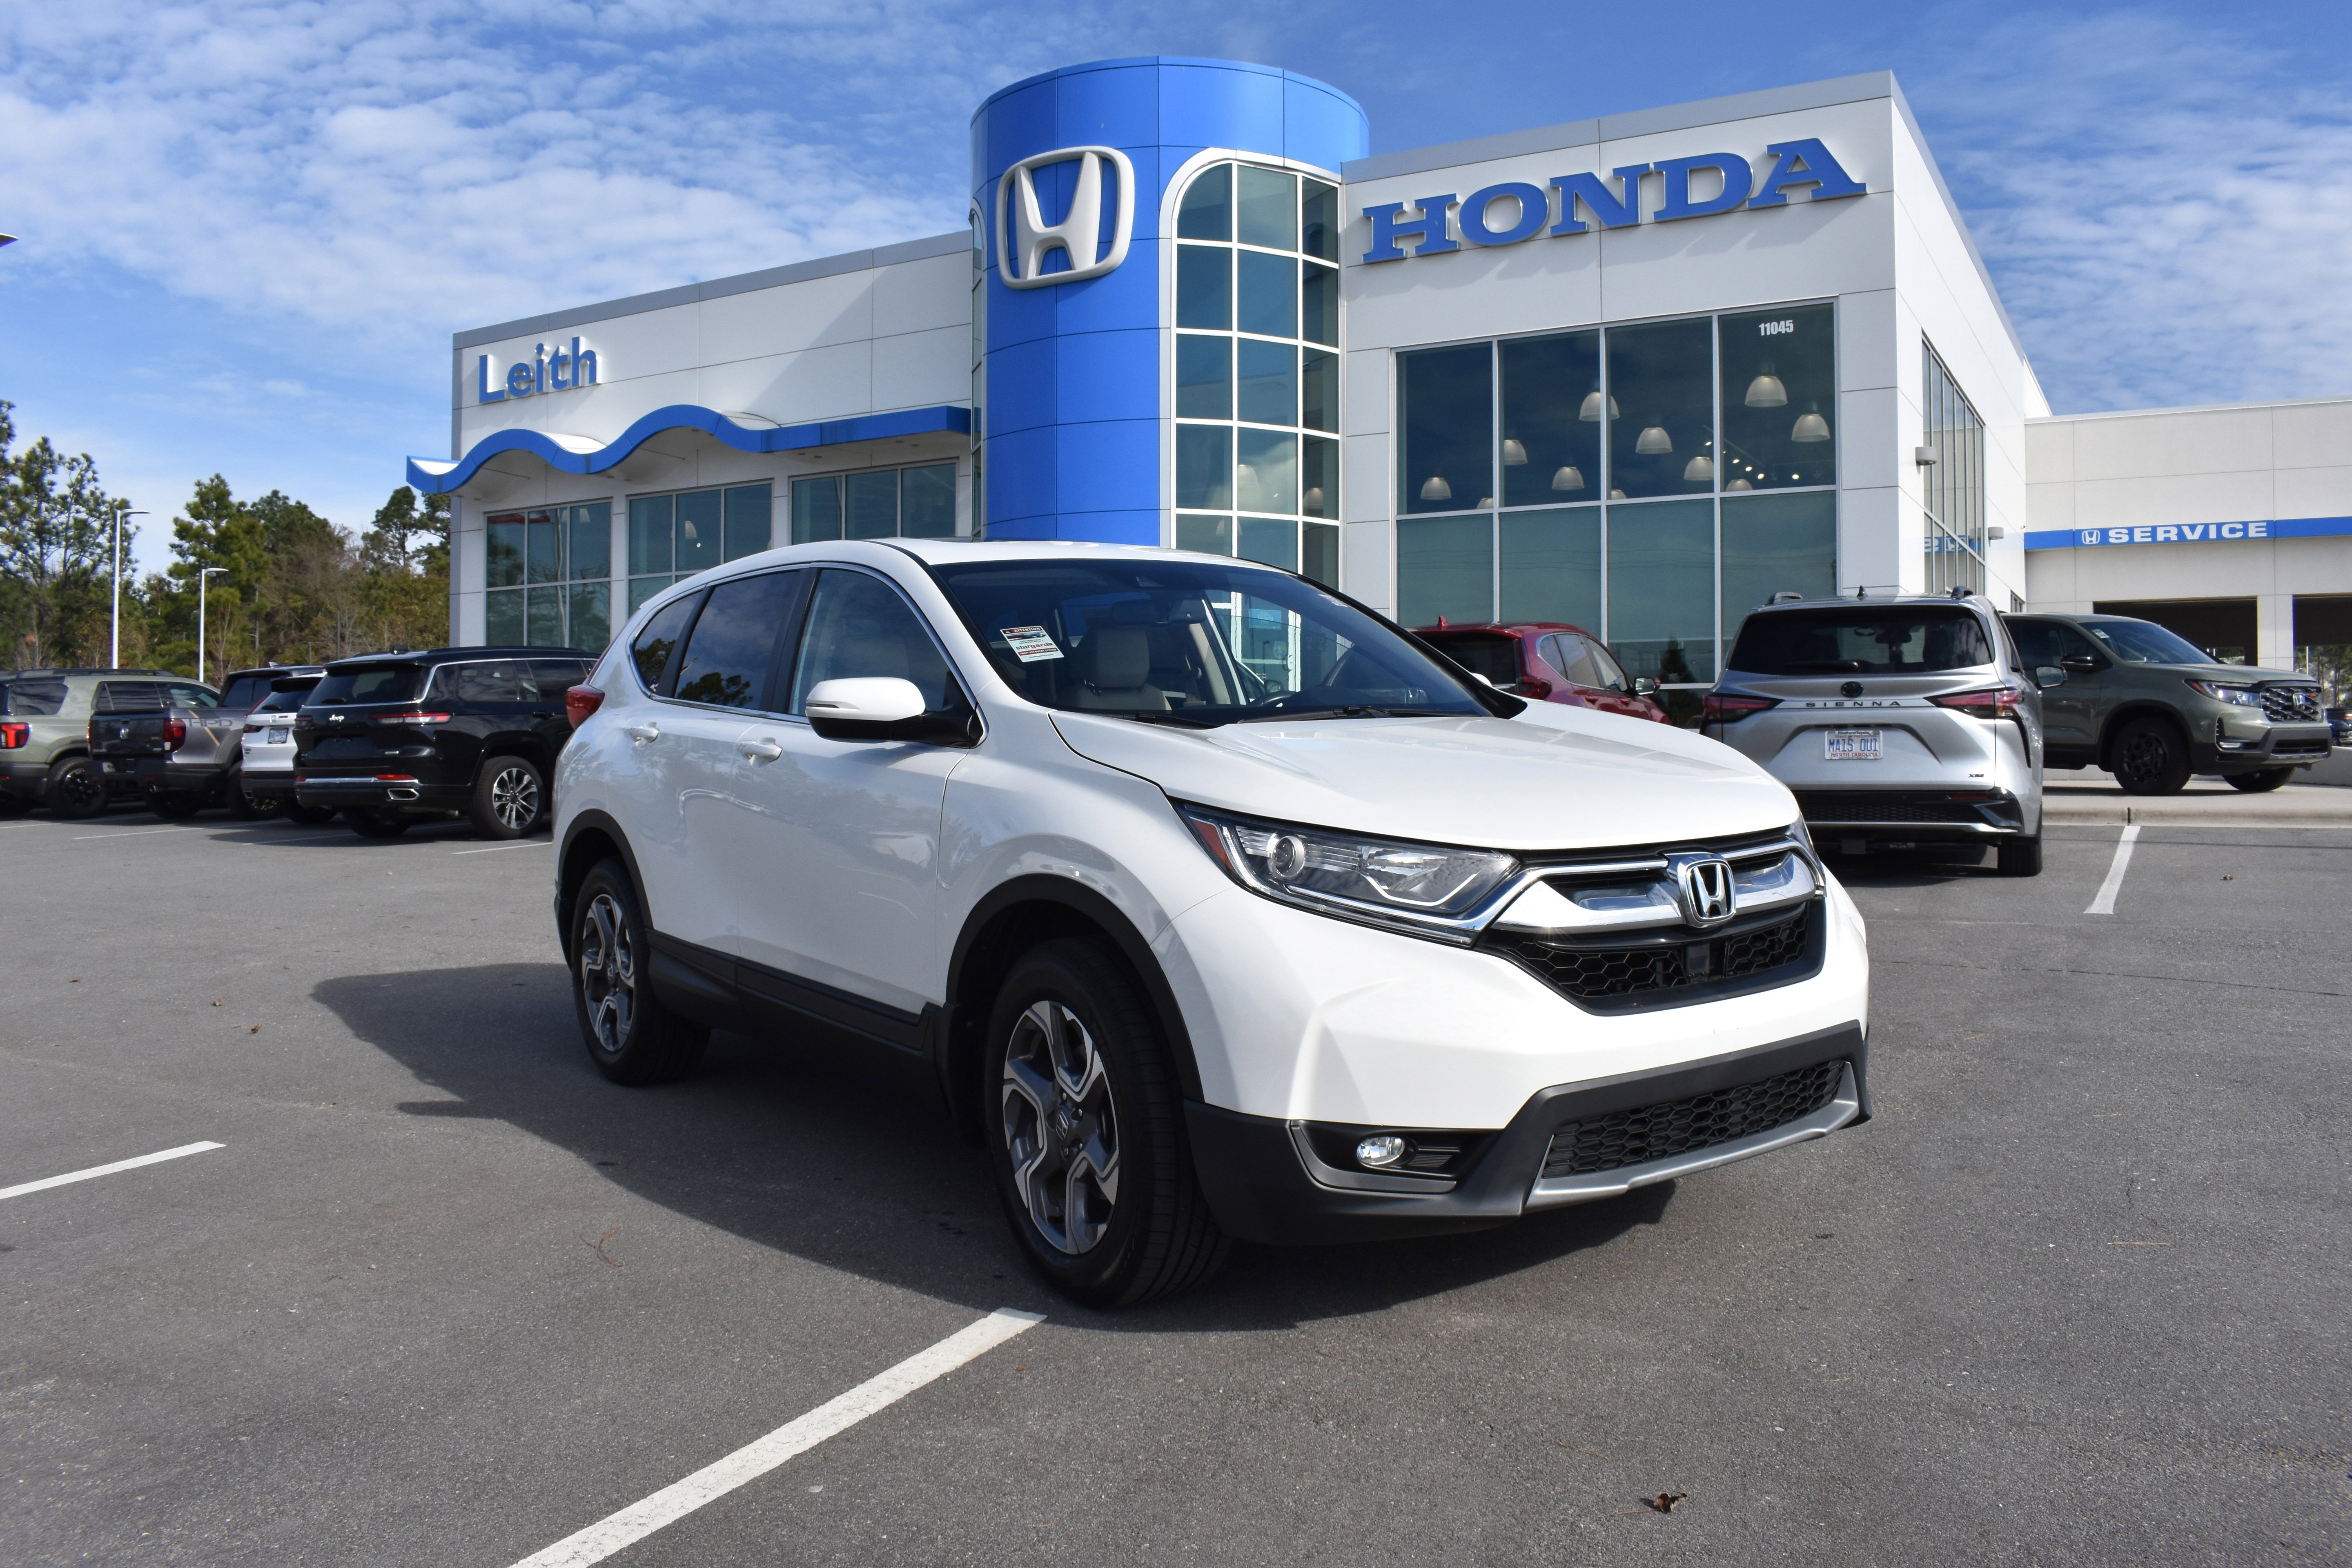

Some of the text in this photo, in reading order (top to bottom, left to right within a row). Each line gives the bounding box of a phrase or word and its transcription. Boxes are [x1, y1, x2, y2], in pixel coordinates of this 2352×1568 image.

[1362, 138, 1867, 263] HONDA
[1759, 320, 1794, 336] 11045
[479, 336, 599, 404] Leith
[2108, 522, 2267, 543] SERVICE
